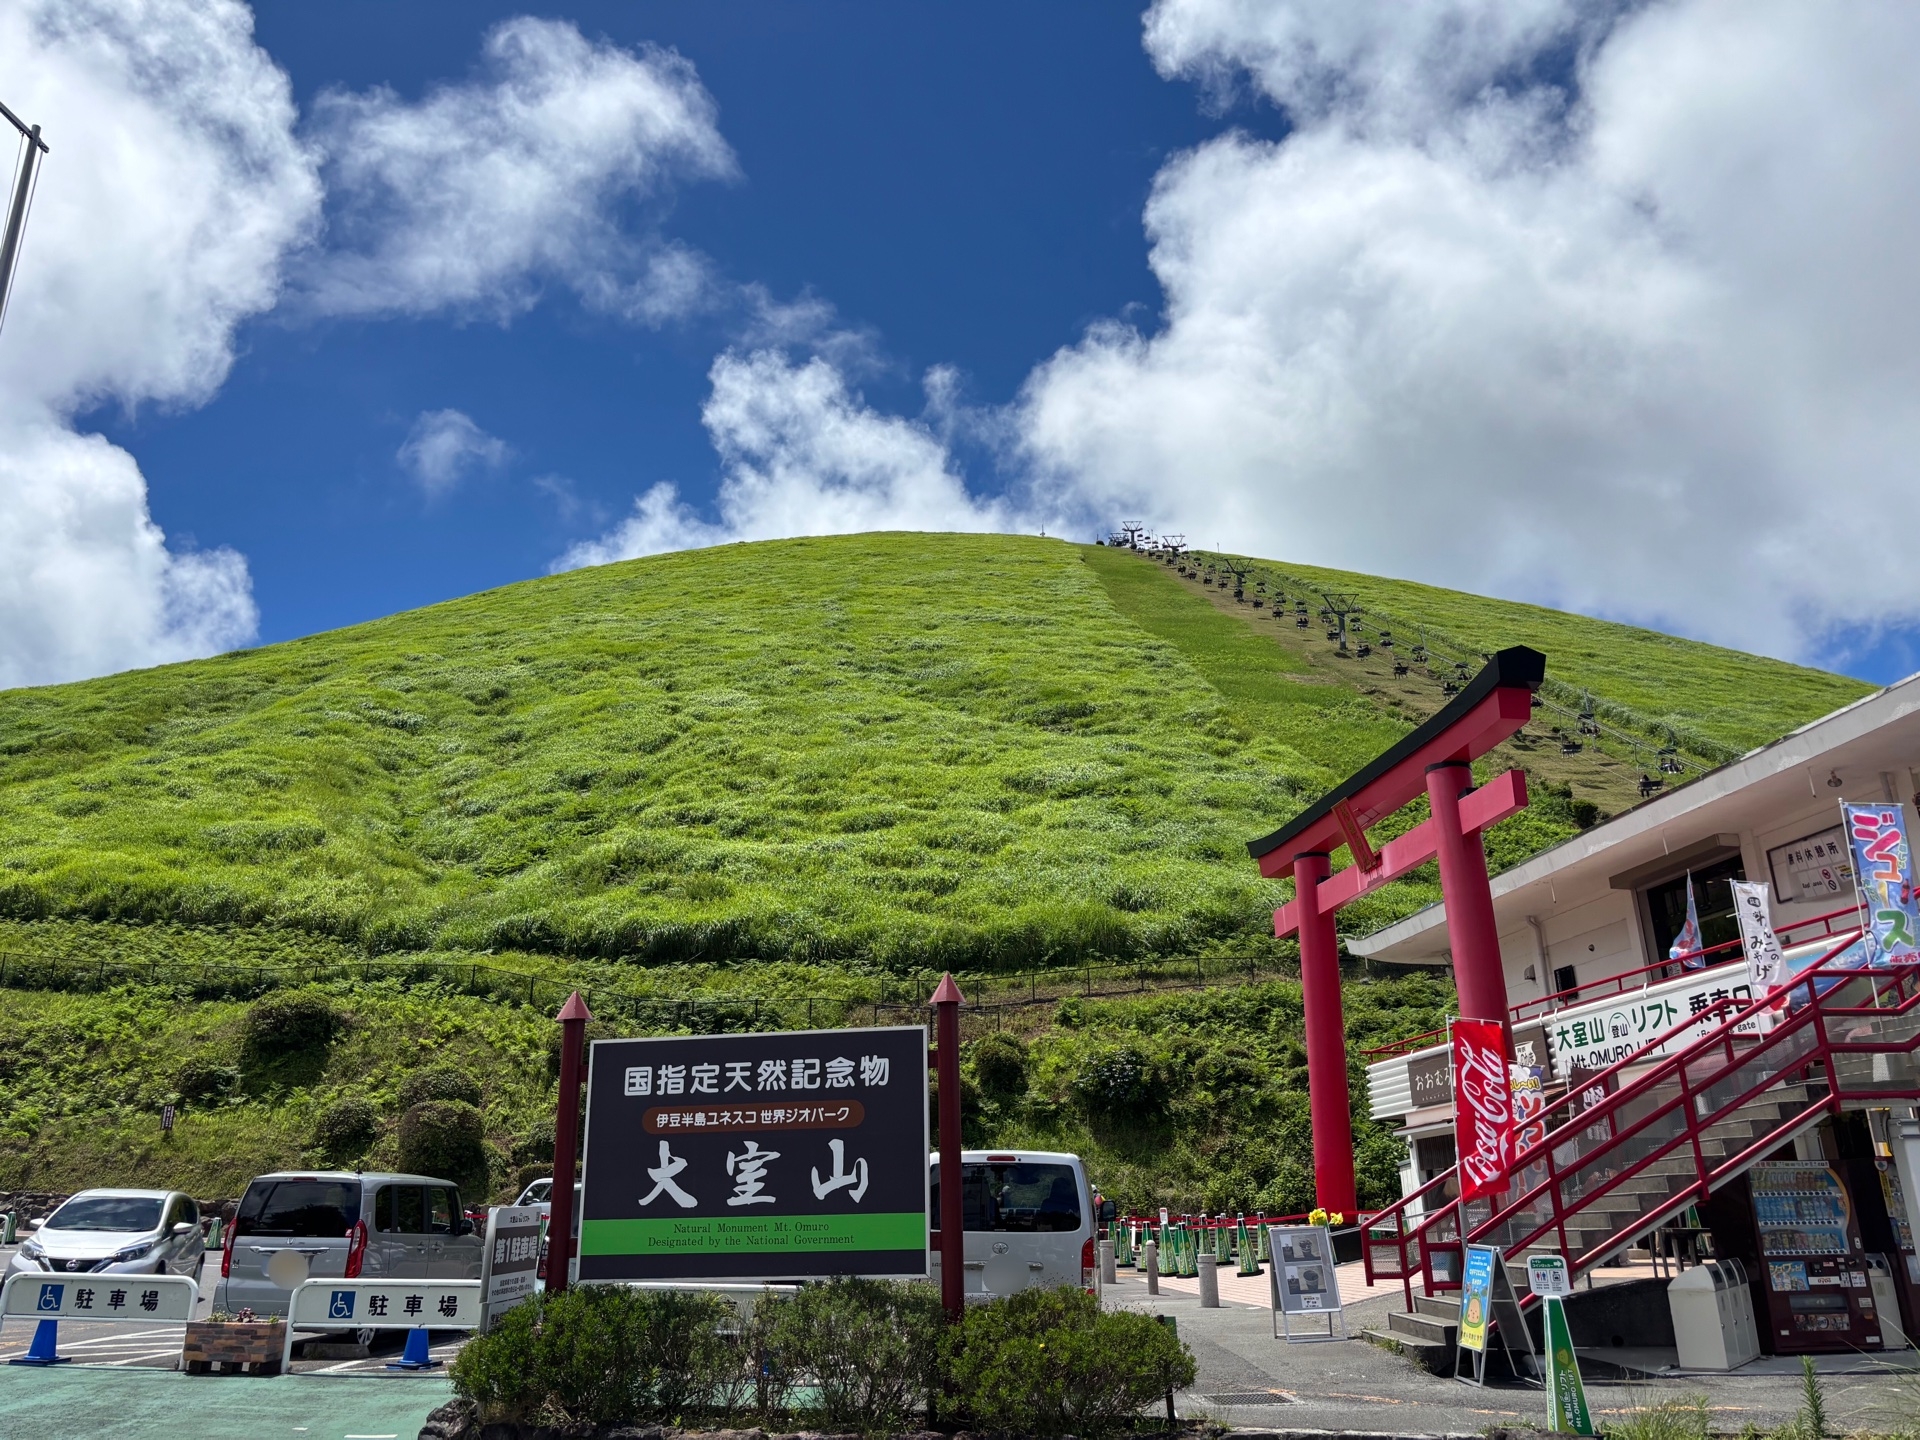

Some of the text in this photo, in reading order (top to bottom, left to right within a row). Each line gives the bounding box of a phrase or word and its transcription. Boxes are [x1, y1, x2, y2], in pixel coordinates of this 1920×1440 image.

[1852, 812, 1915, 952] ジュース
[1750, 936, 1772, 980] みやげ
[1890, 952, 1920, 964] 販売
[1556, 984, 1754, 1051] 大室山 登山 リフト 乗車口
[1737, 1021, 1757, 1032] gate
[1571, 1042, 1634, 1069] Mt.OMURO
[624, 1055, 890, 1097] 国指定天然記念物
[656, 1107, 850, 1128] 伊豆半島ユネスコ 世界ジオパーク
[1459, 1036, 1509, 1187] Coca-Cola
[638, 1138, 869, 1208] 大室山
[648, 1234, 855, 1248] Designated by the National Government
[674, 1222, 829, 1234] Natural Monument Mt. Omuro
[494, 1235, 538, 1265] 第1駐車場
[73, 1288, 159, 1312] 駐車場
[369, 1294, 459, 1318] 駐車場
